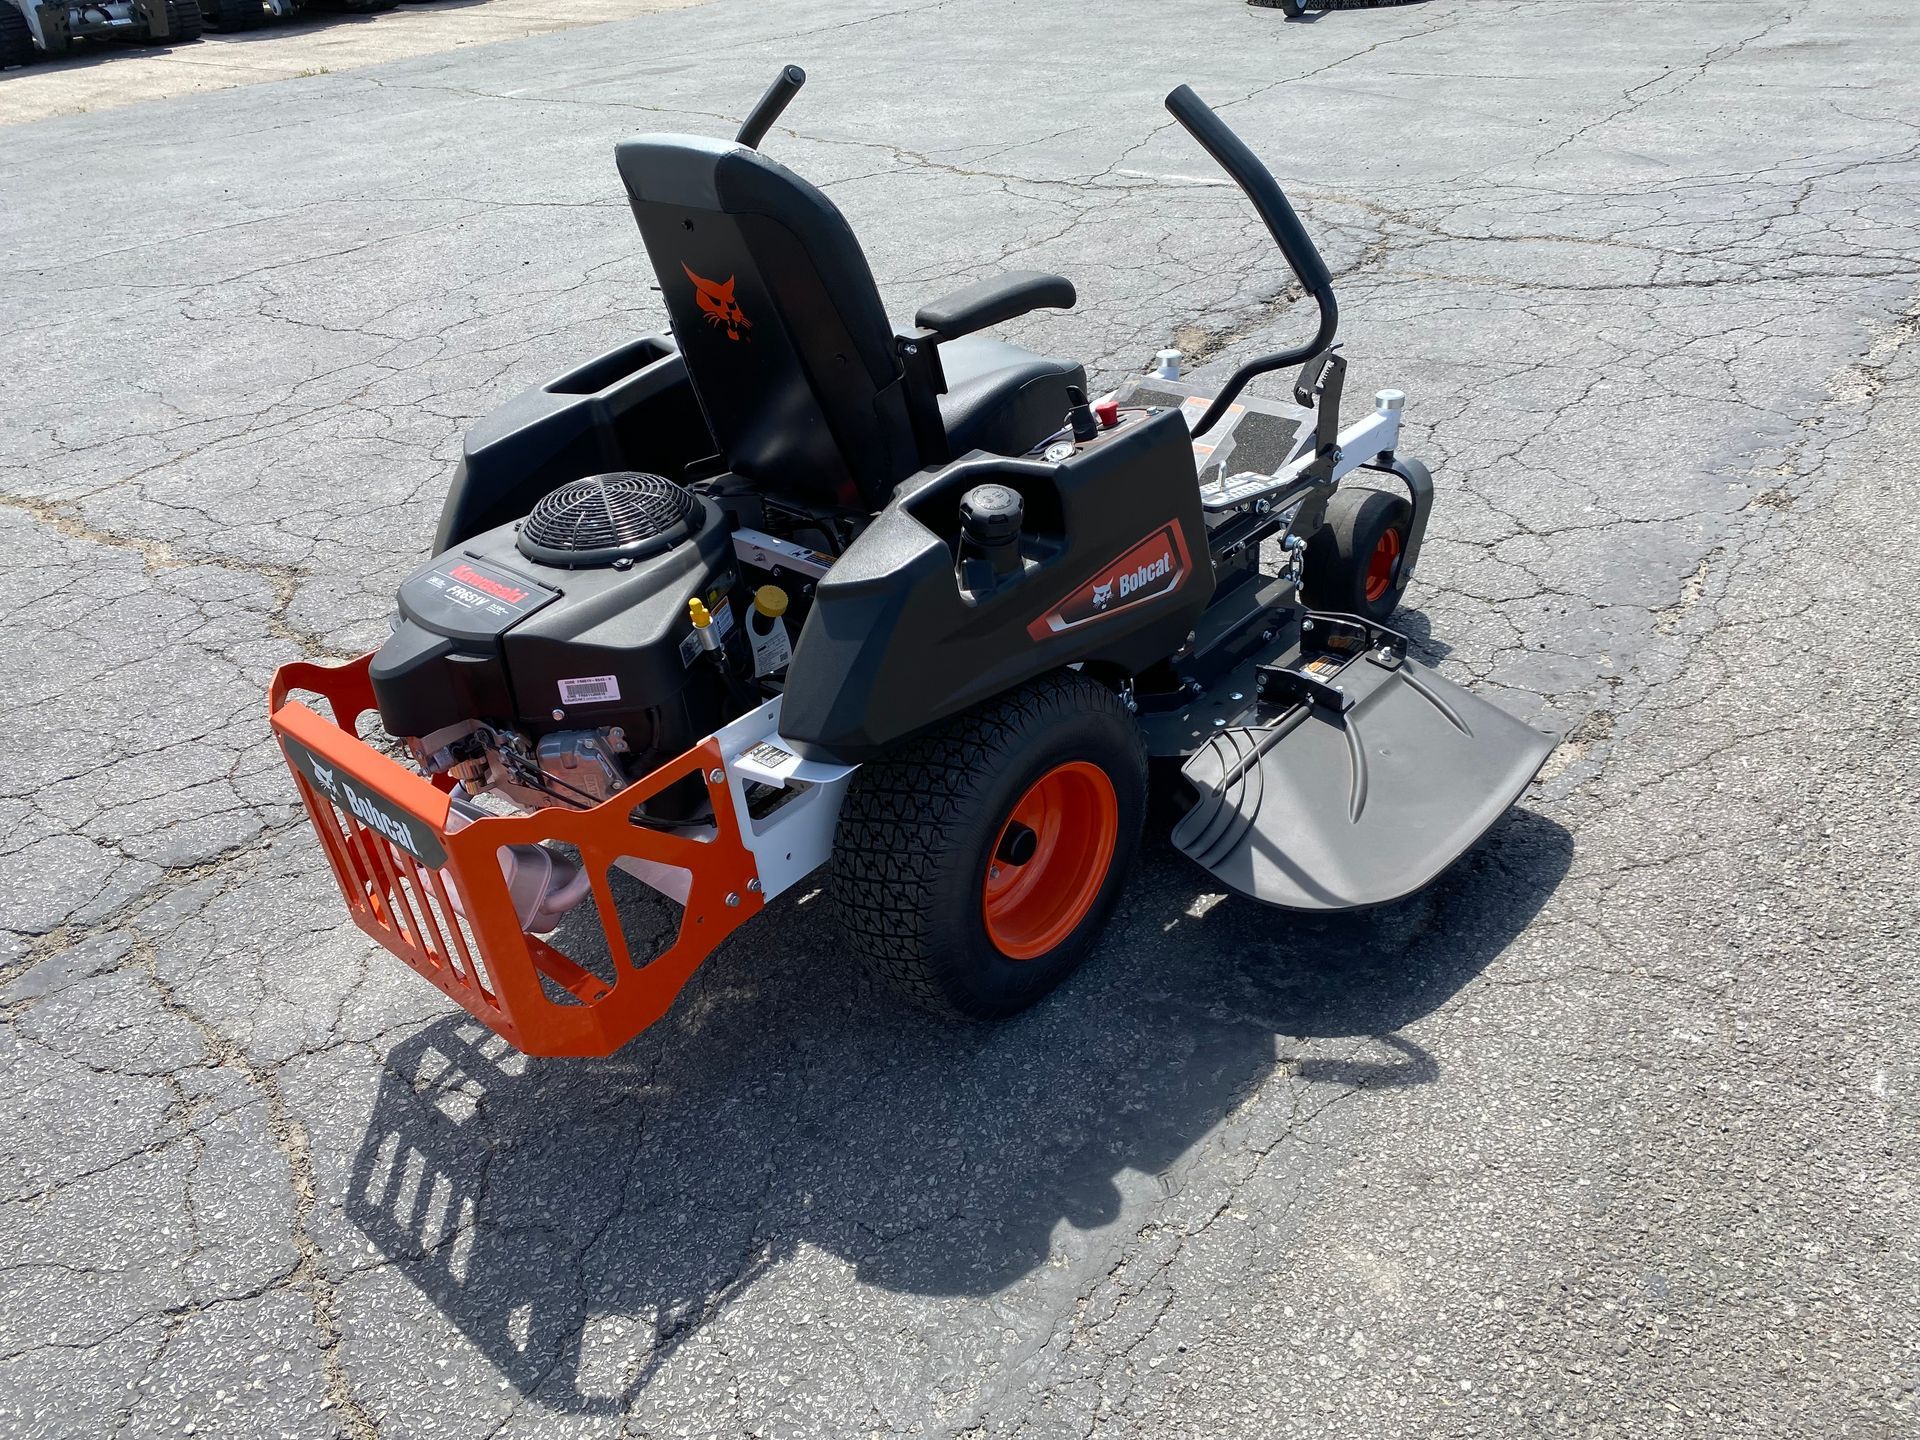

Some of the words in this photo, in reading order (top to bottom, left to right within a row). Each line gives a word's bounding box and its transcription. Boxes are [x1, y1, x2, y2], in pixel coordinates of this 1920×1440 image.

[446, 585, 491, 606] FR651V
[448, 564, 530, 604] Kawasaki
[1119, 552, 1170, 598] Bobcat
[341, 782, 419, 856] Bobcat
